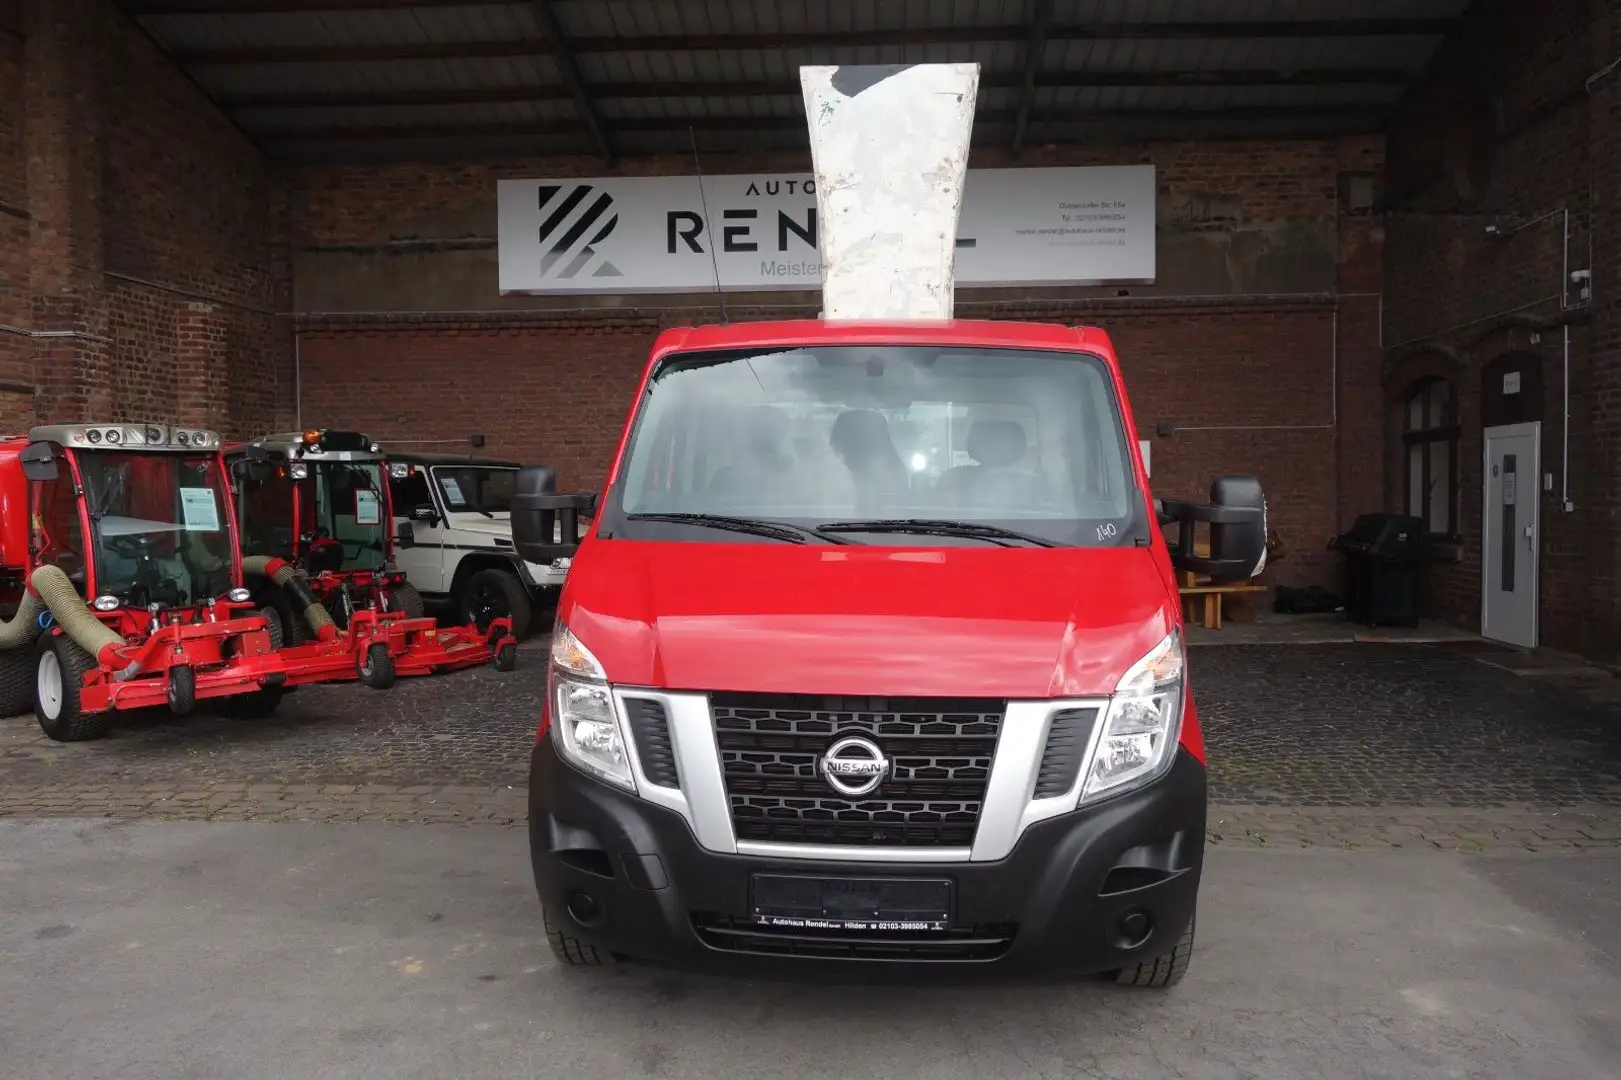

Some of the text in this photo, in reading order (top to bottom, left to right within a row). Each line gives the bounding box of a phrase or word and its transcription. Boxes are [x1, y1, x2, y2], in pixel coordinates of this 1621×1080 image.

[746, 180, 817, 196] AUTO
[827, 762, 881, 773] NISSAN
[772, 917, 804, 927] Autohaus
[805, 919, 829, 929] Rendel
[844, 922, 867, 930] Hilden
